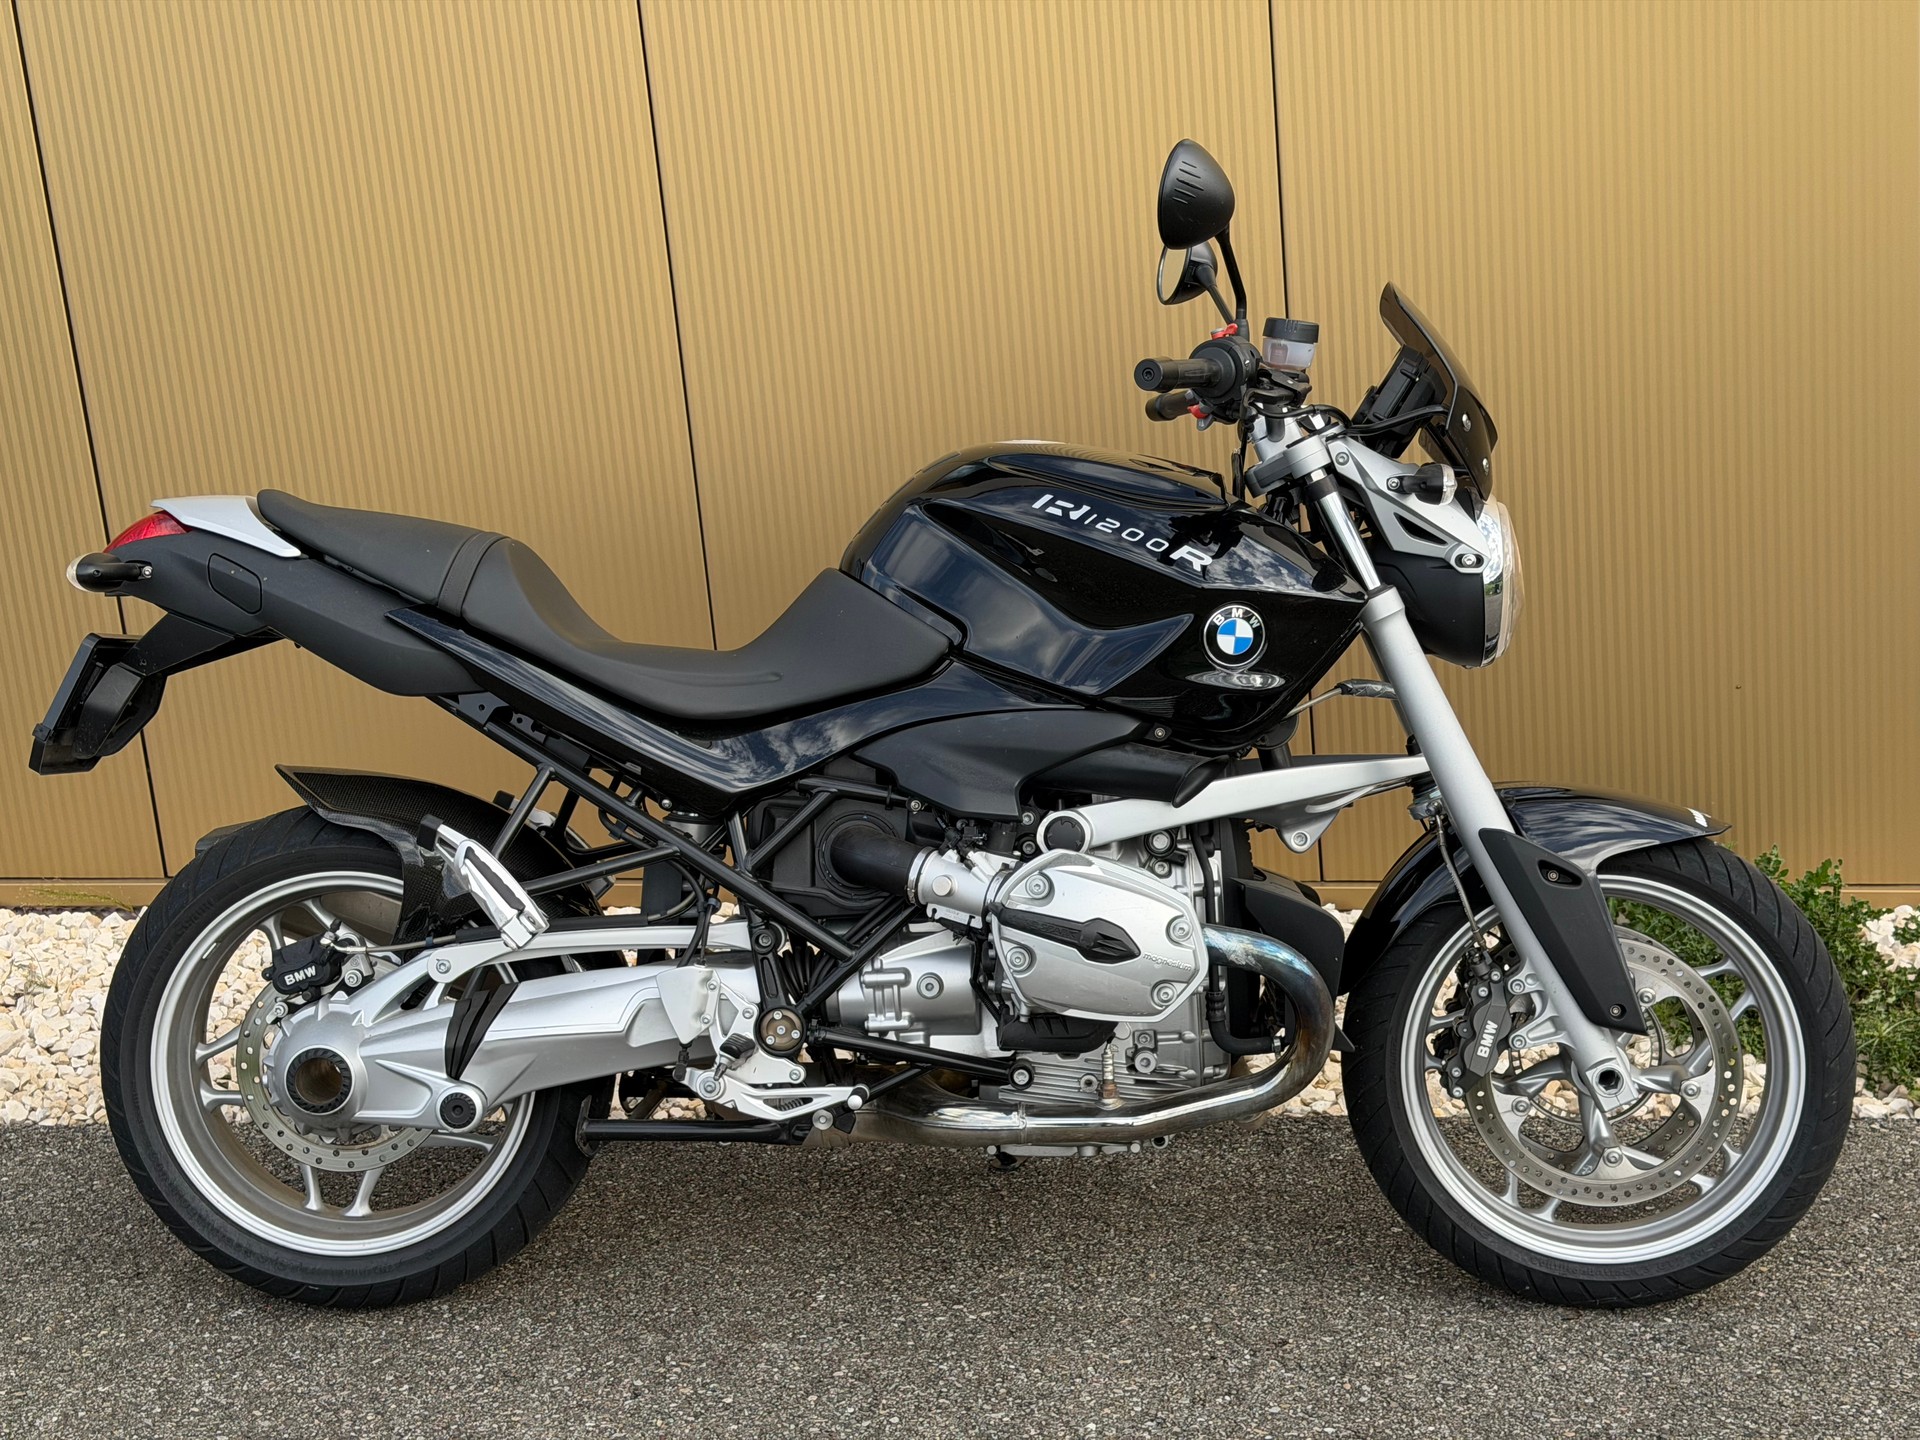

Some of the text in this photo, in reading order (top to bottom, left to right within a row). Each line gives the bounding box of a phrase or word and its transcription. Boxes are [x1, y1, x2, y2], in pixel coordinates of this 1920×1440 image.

[1213, 607, 1261, 629] BMW
[1142, 952, 1192, 972] magnesium
[284, 965, 316, 986] BMW
[1476, 1020, 1498, 1058] BMW
